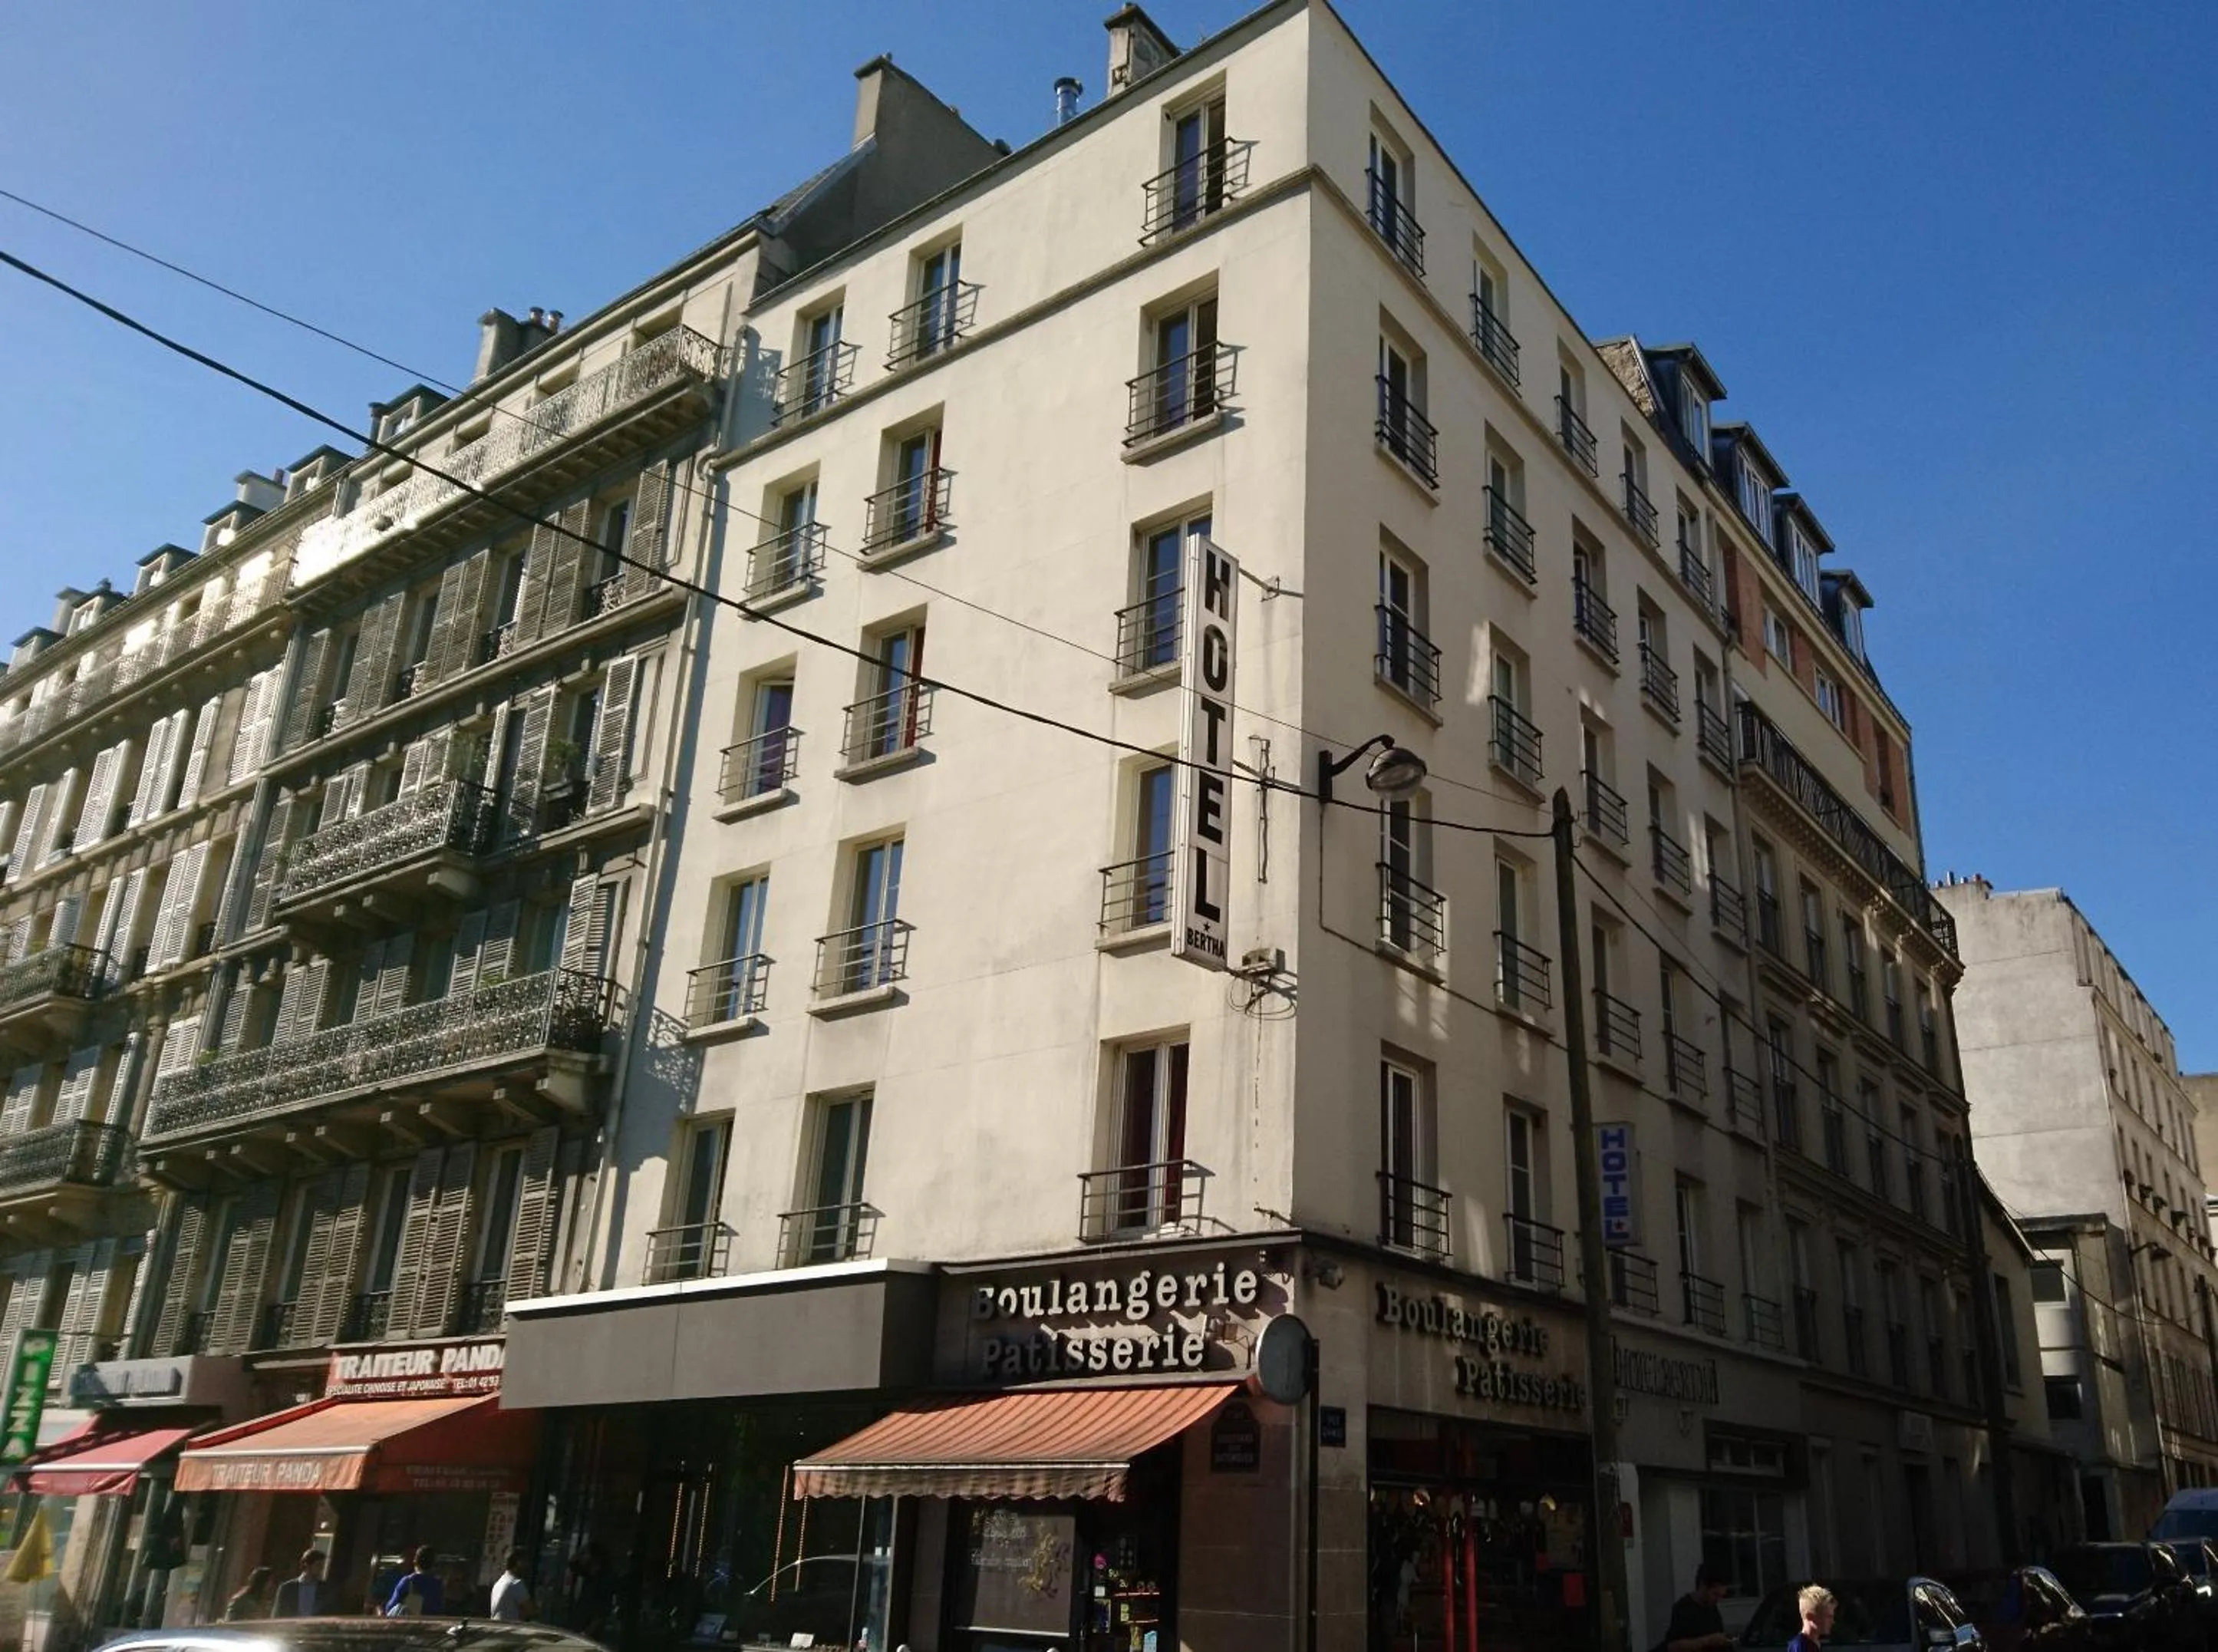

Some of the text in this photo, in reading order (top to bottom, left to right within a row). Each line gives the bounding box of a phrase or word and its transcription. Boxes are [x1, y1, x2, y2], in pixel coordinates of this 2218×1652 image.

[1194, 548, 1231, 925] HOTEL
[1186, 925, 1225, 961] BERTHA
[1600, 1128, 1630, 1240] HOTEL
[971, 1261, 1258, 1321] Boulangerie
[1382, 1282, 1551, 1358] Boulangerie
[335, 1349, 437, 1380] TRAITEUR
[983, 1322, 1208, 1377] Patisserie
[2, 1337, 50, 1459] PIZZA
[212, 1460, 322, 1485] TRAITEUR PANDA
